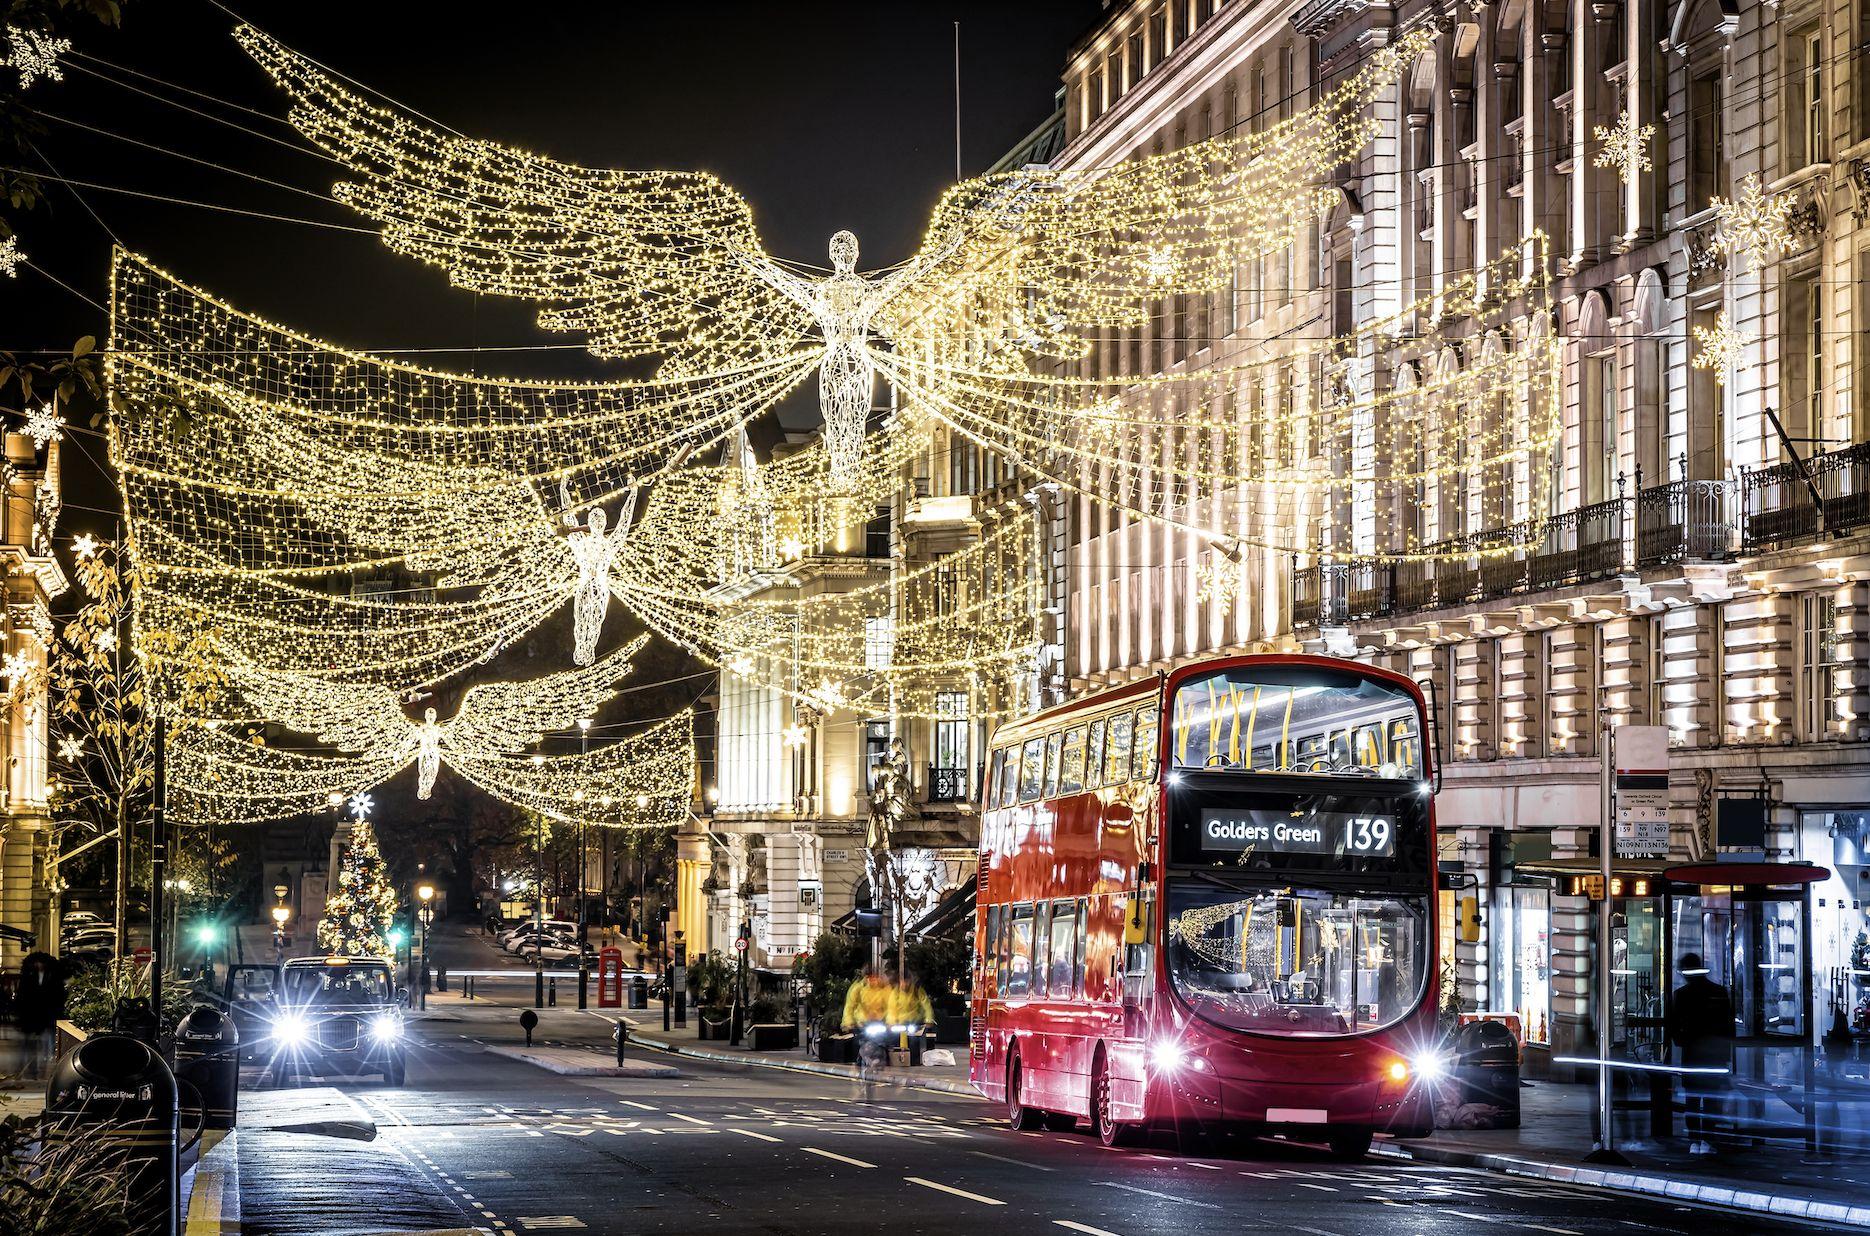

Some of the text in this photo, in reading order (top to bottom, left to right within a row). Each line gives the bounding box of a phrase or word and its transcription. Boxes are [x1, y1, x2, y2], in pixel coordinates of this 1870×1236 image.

[1208, 819, 1321, 842] Golders Green
[1345, 818, 1390, 850] 139
[93, 1091, 119, 1099] general
